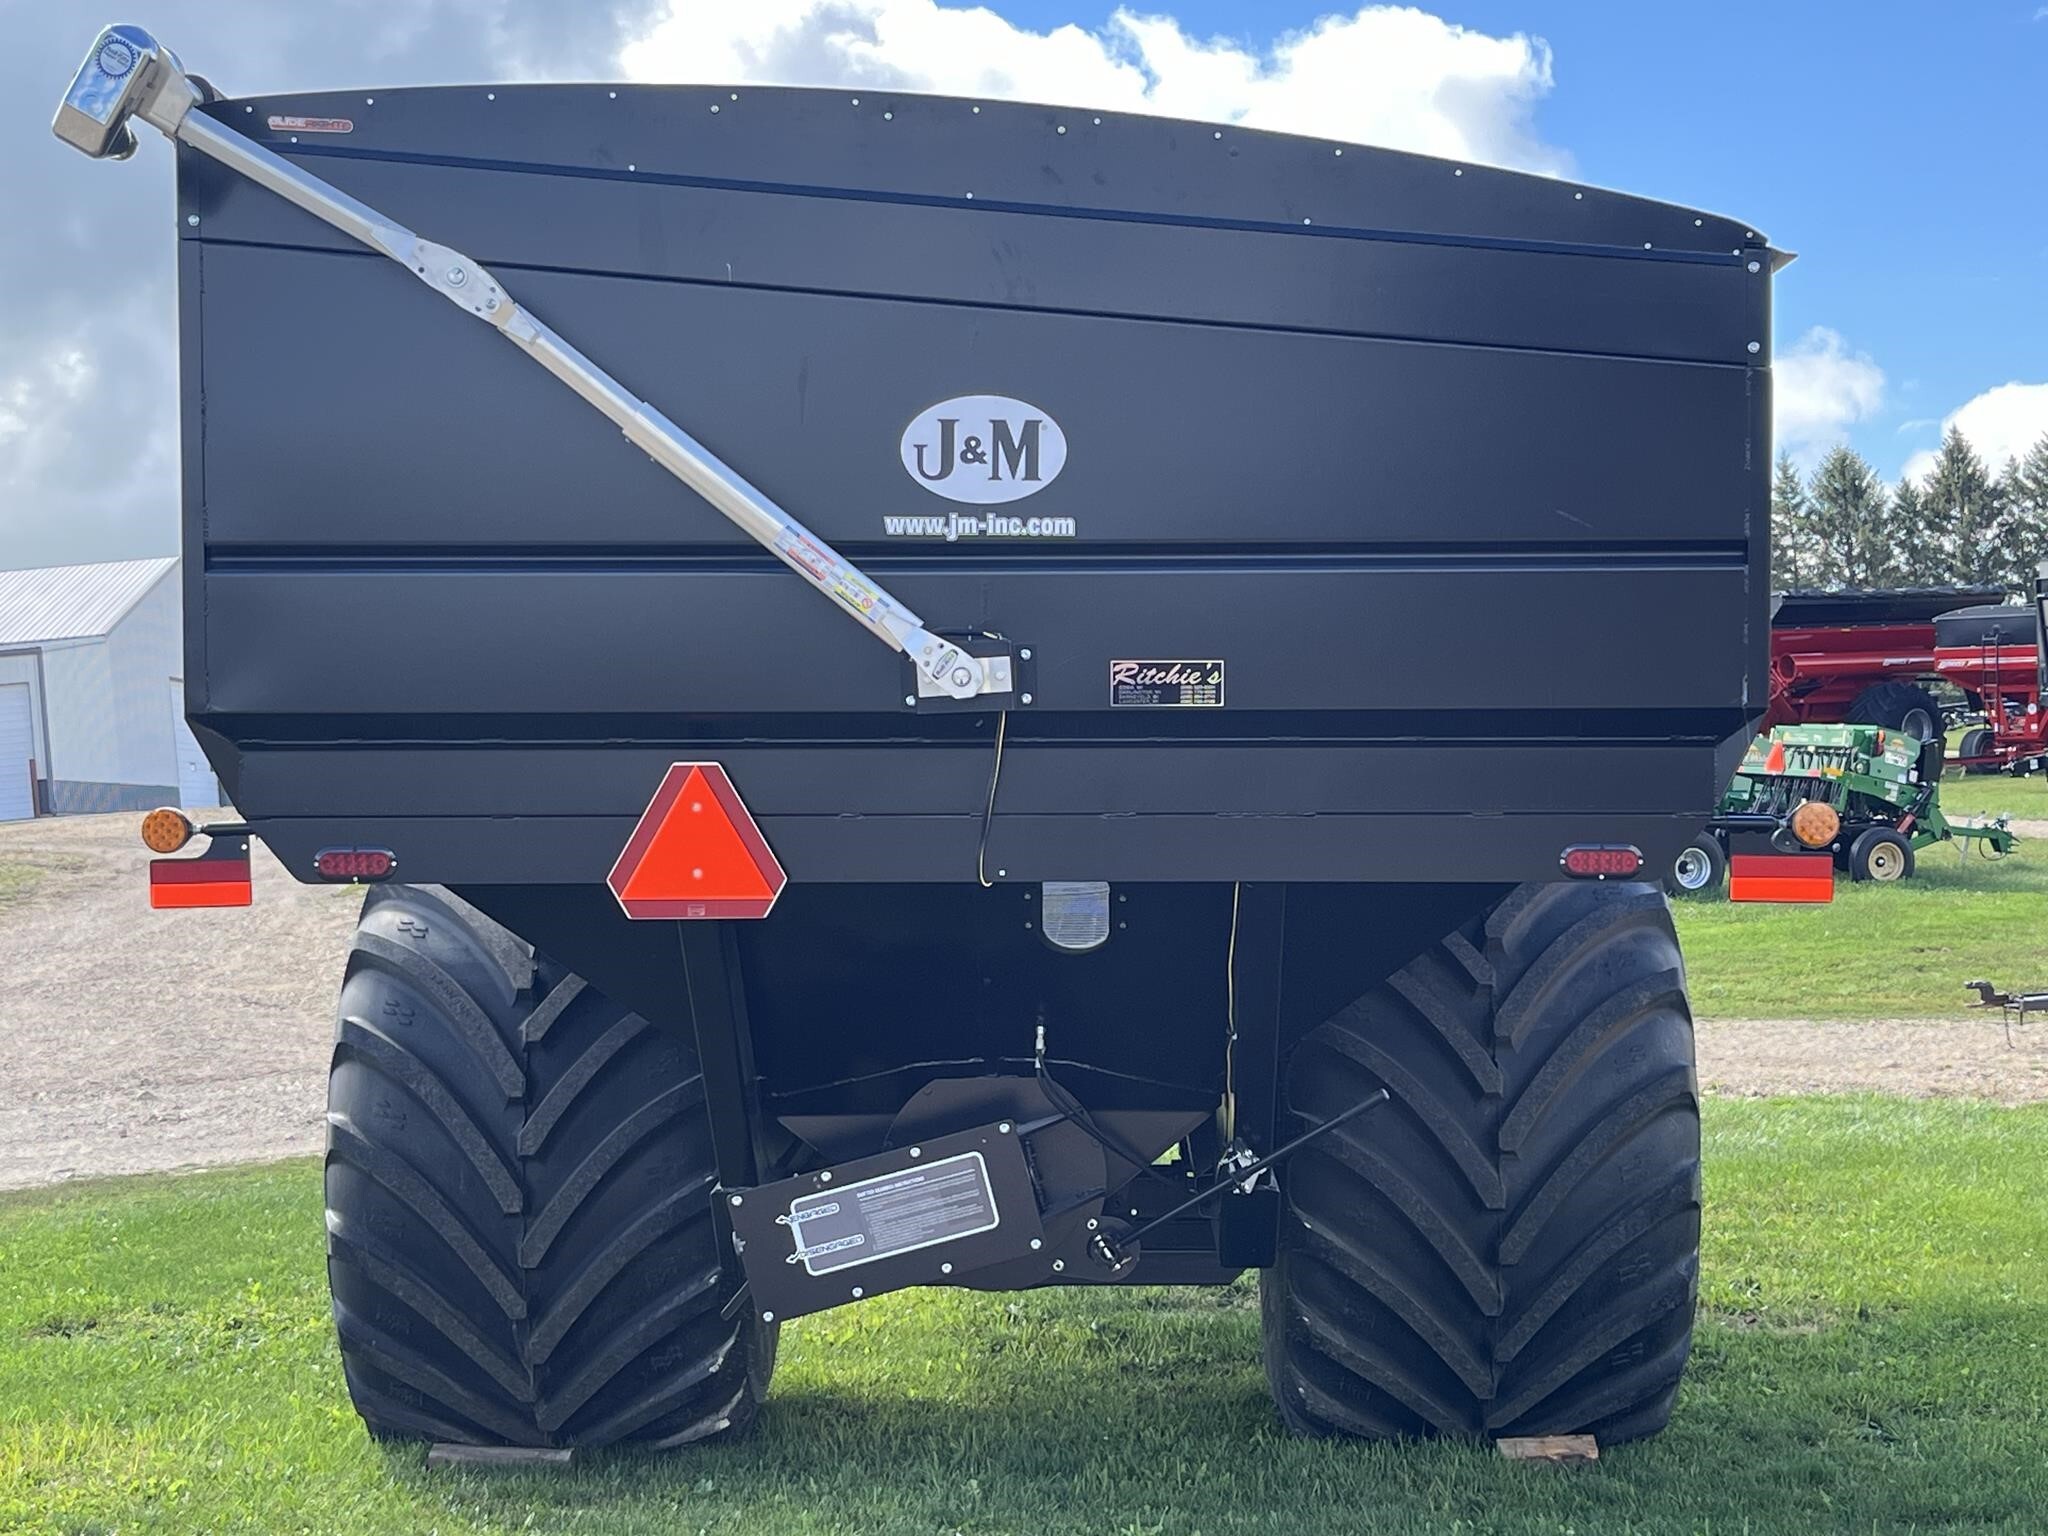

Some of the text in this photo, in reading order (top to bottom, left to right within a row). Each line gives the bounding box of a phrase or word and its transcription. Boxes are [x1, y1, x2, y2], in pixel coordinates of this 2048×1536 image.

[913, 418, 1043, 481] J&M
[883, 513, 1076, 541] www.jm-inc.com
[1113, 662, 1222, 685] Ritchie's
